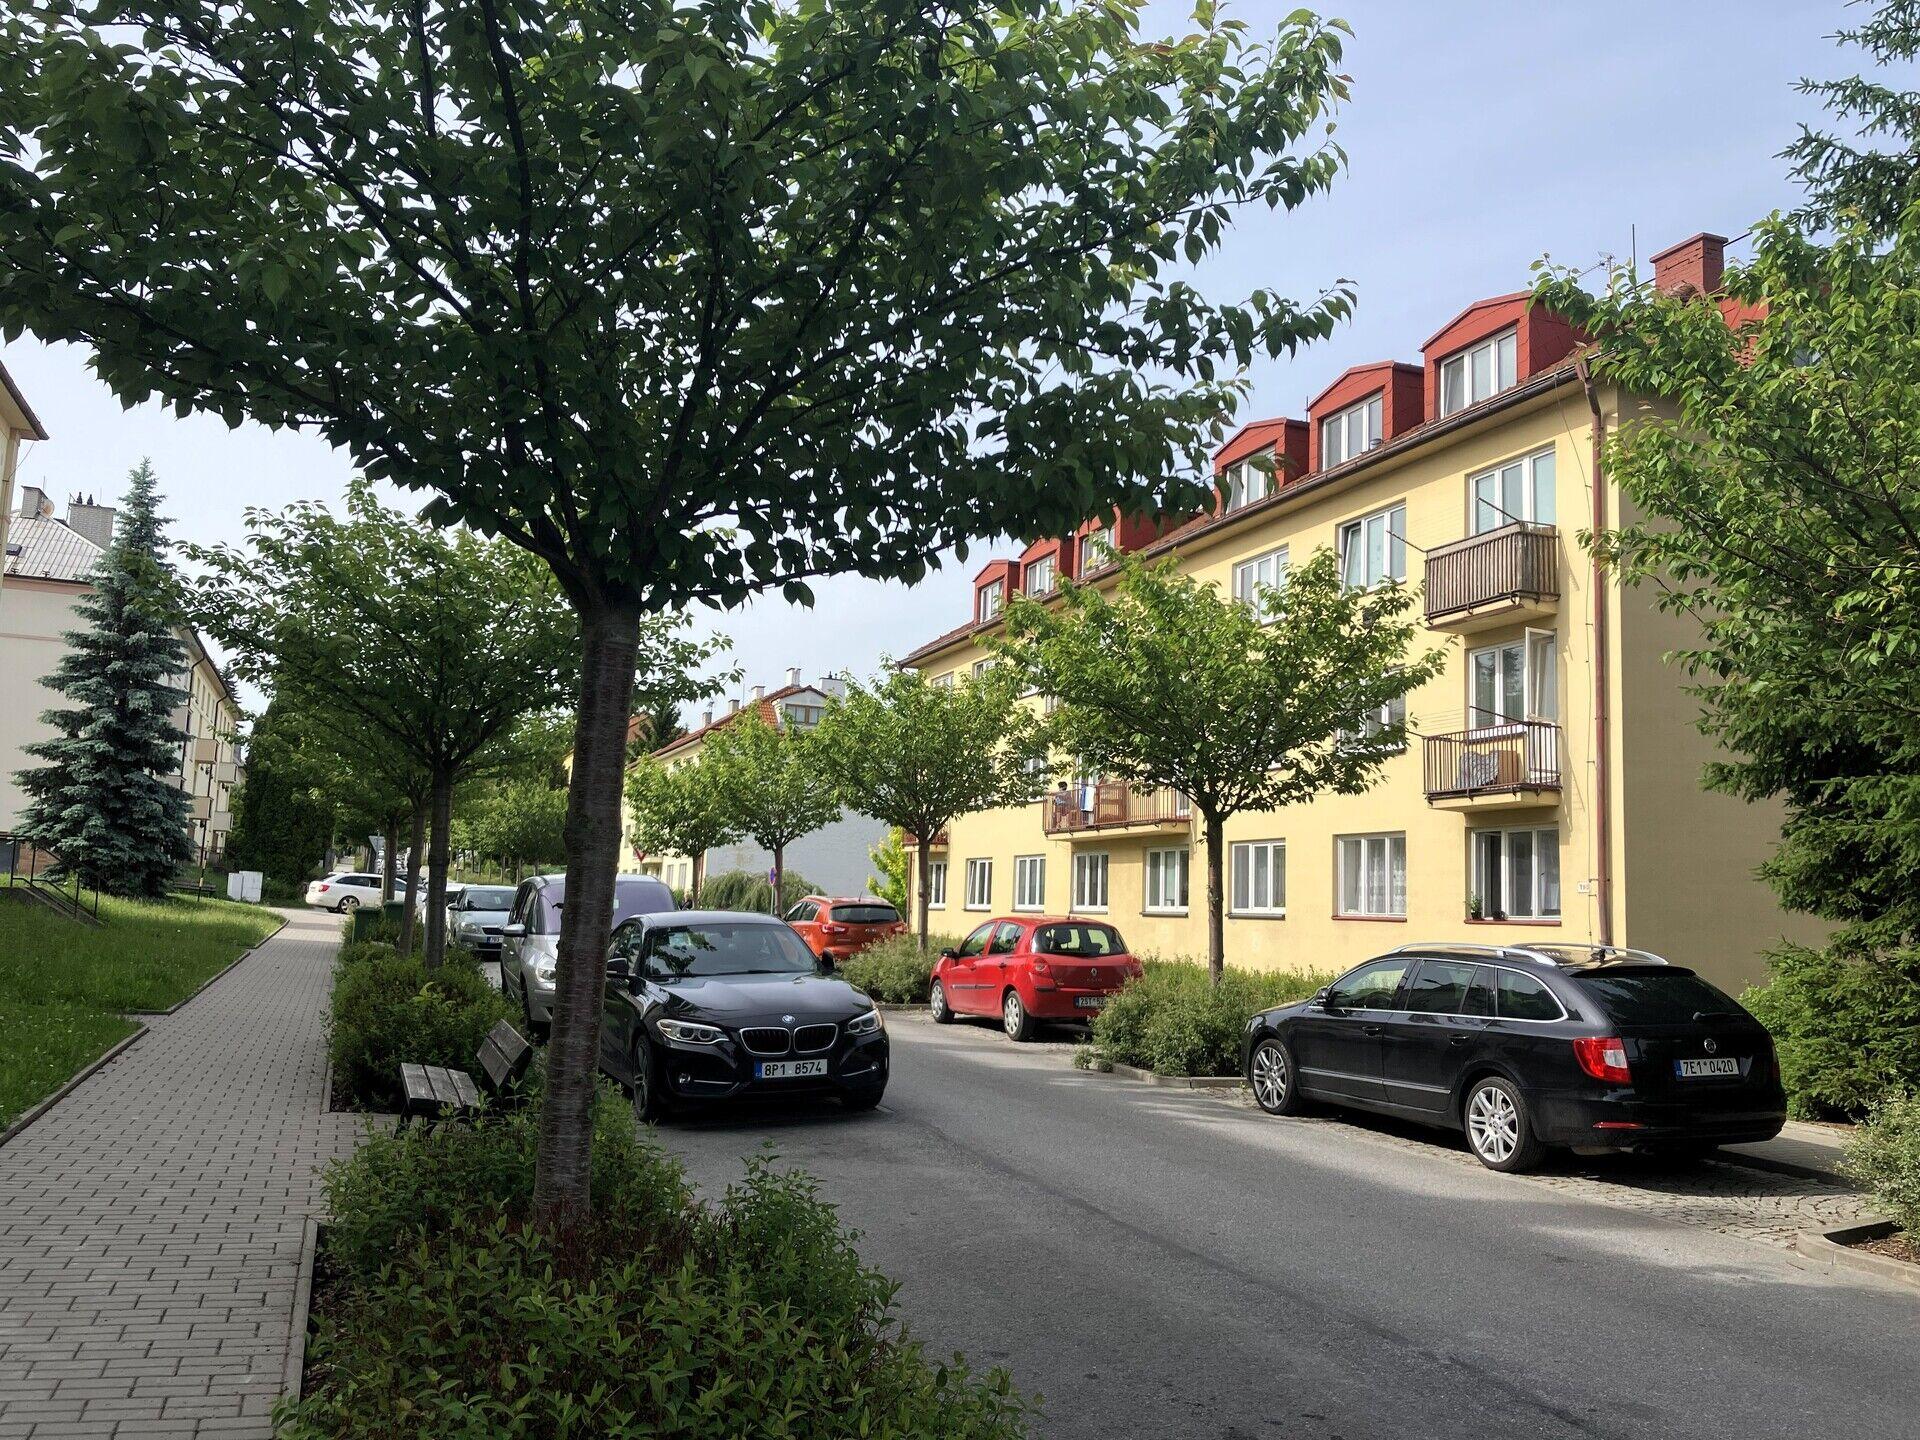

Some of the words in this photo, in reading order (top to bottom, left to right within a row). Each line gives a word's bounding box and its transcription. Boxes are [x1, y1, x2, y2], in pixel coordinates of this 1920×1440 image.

[764, 1063, 786, 1077] 8P1
[794, 1061, 823, 1075] 8574
[1682, 1061, 1703, 1075] 7E1
[1709, 1059, 1734, 1074] 0420
